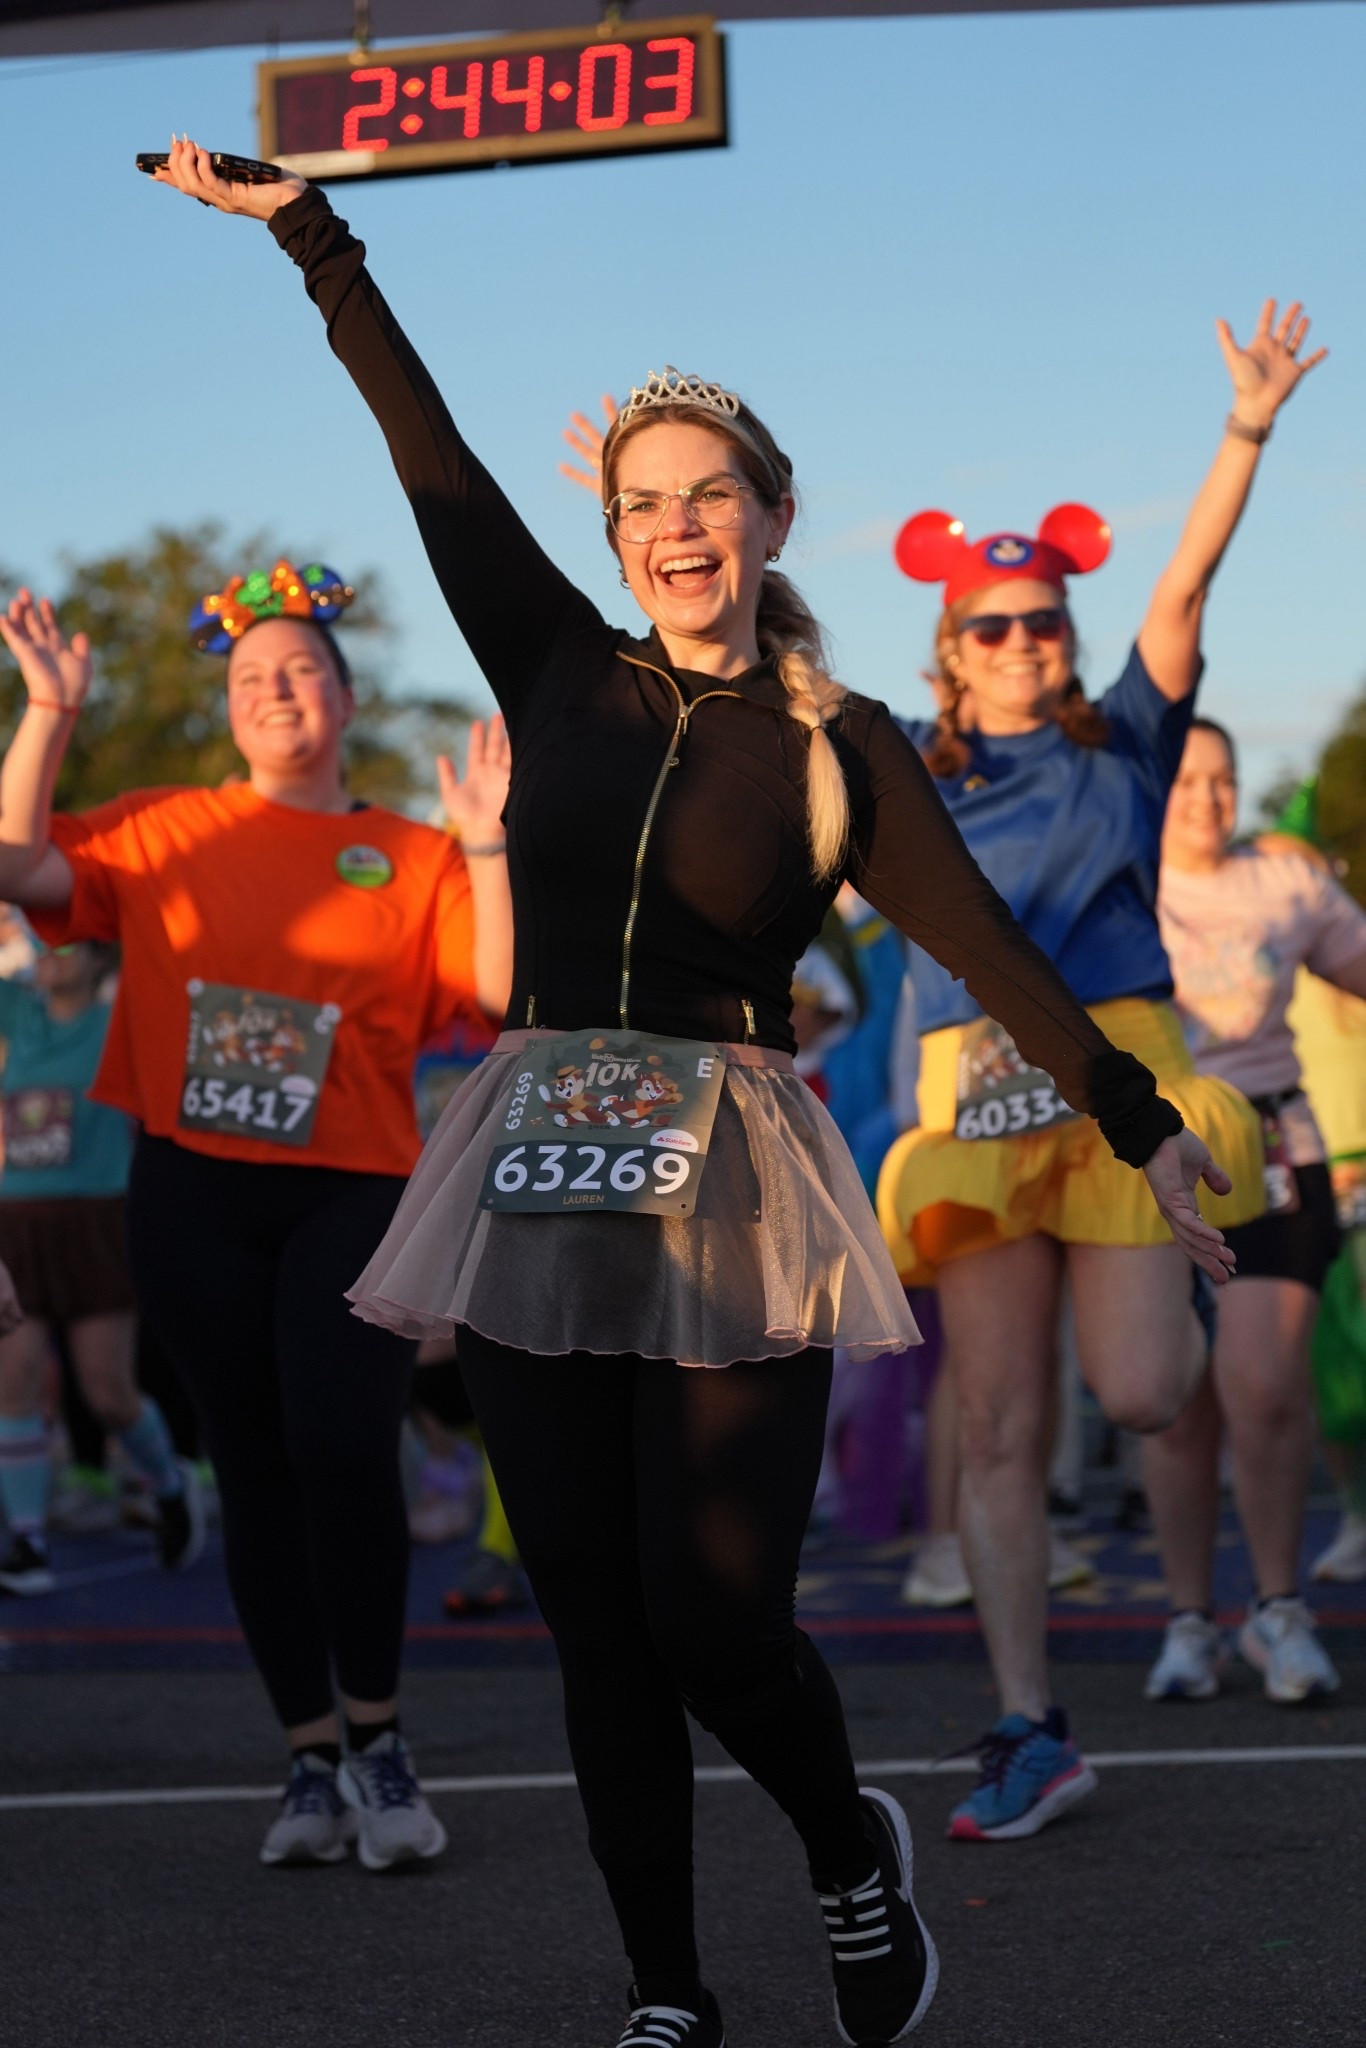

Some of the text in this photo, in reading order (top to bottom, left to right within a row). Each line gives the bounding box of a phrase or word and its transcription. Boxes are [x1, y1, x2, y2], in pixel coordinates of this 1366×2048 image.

[585, 1061, 640, 1088] 10K
[696, 1057, 715, 1078] E
[182, 1076, 312, 1132] 65417
[505, 1072, 533, 1130] 63269
[494, 1145, 690, 1194] 63269
[562, 1194, 605, 1205] LAUREN
